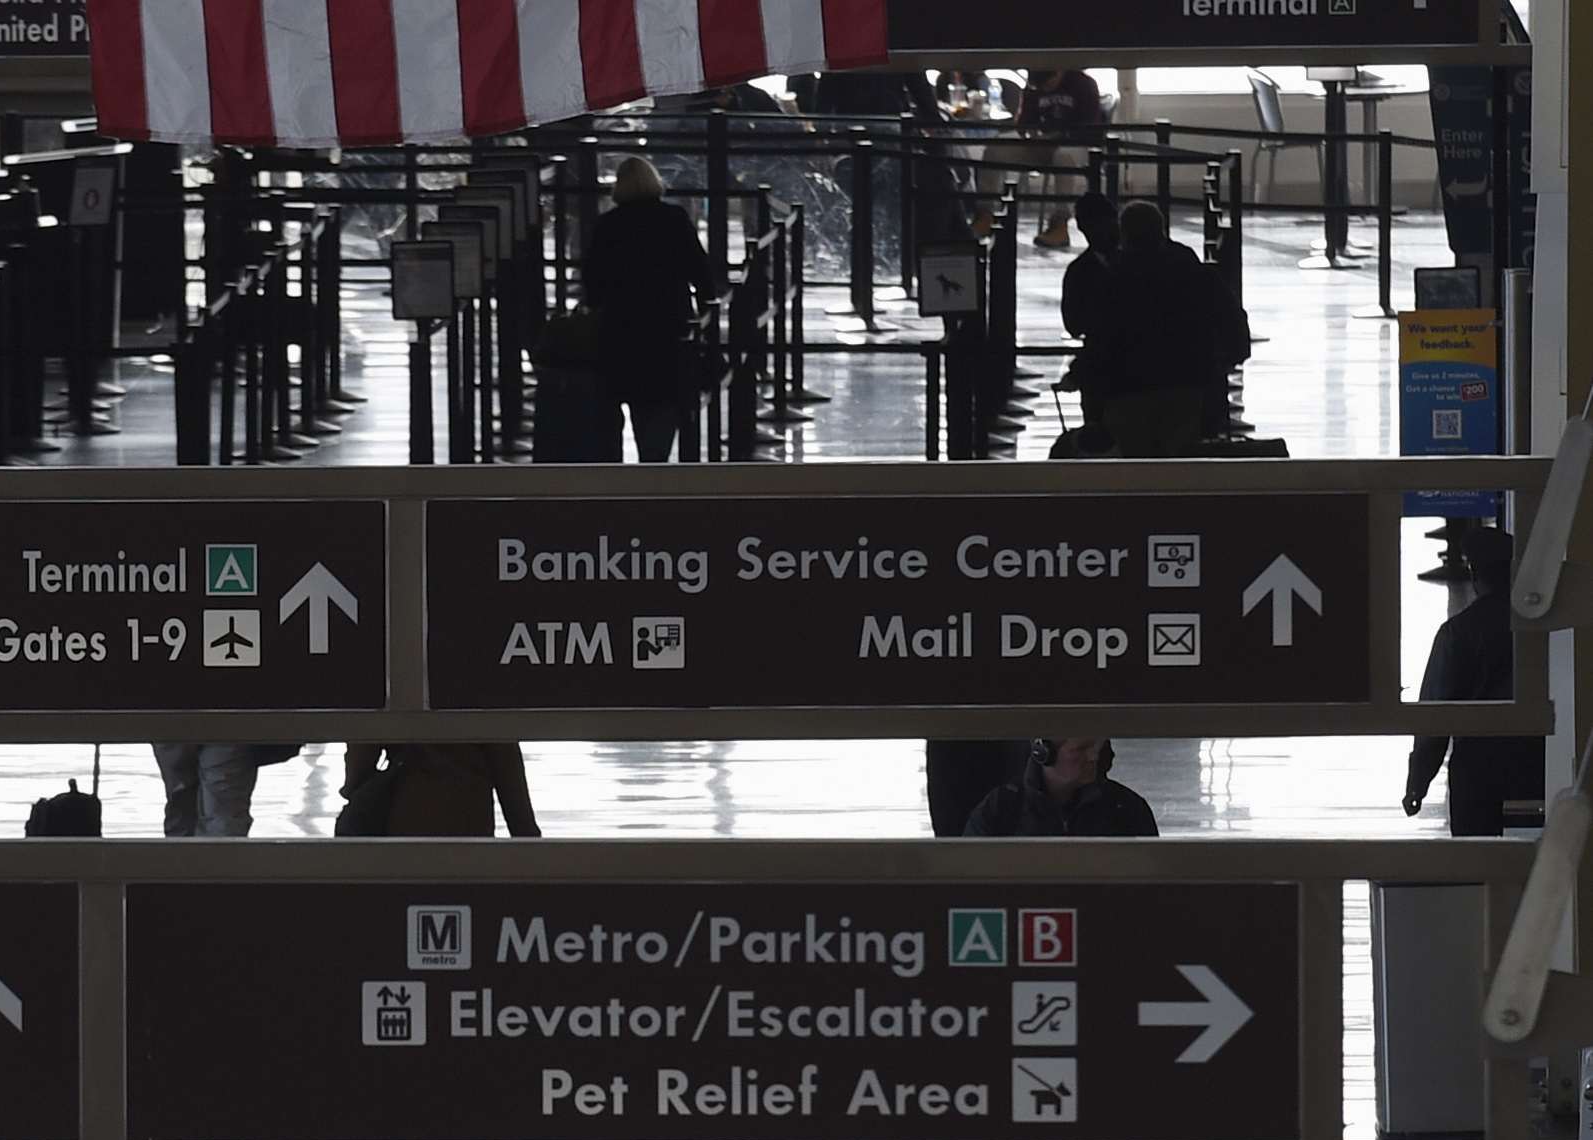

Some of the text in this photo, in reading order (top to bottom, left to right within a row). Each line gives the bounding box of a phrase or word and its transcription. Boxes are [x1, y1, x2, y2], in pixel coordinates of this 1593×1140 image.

[1441, 128, 1484, 143] Enter
[1443, 145, 1482, 159] Here
[1408, 324, 1486, 336] We want your
[1420, 339, 1475, 349] feedback.
[1406, 385, 1420, 393] Get
[1429, 384, 1456, 393] chance
[1411, 372, 1429, 380] Give
[22, 547, 249, 592] Terminal A
[498, 535, 1128, 594] Banking Service Center
[127, 617, 187, 661] 1-9
[499, 622, 614, 665] ATM
[859, 612, 1128, 669] Mail Drop
[422, 955, 457, 965] metro
[496, 911, 1063, 978] Metro/Parking A B
[450, 985, 988, 1042] Elevator/Escalator
[542, 1064, 988, 1116] Pet Relief Area
